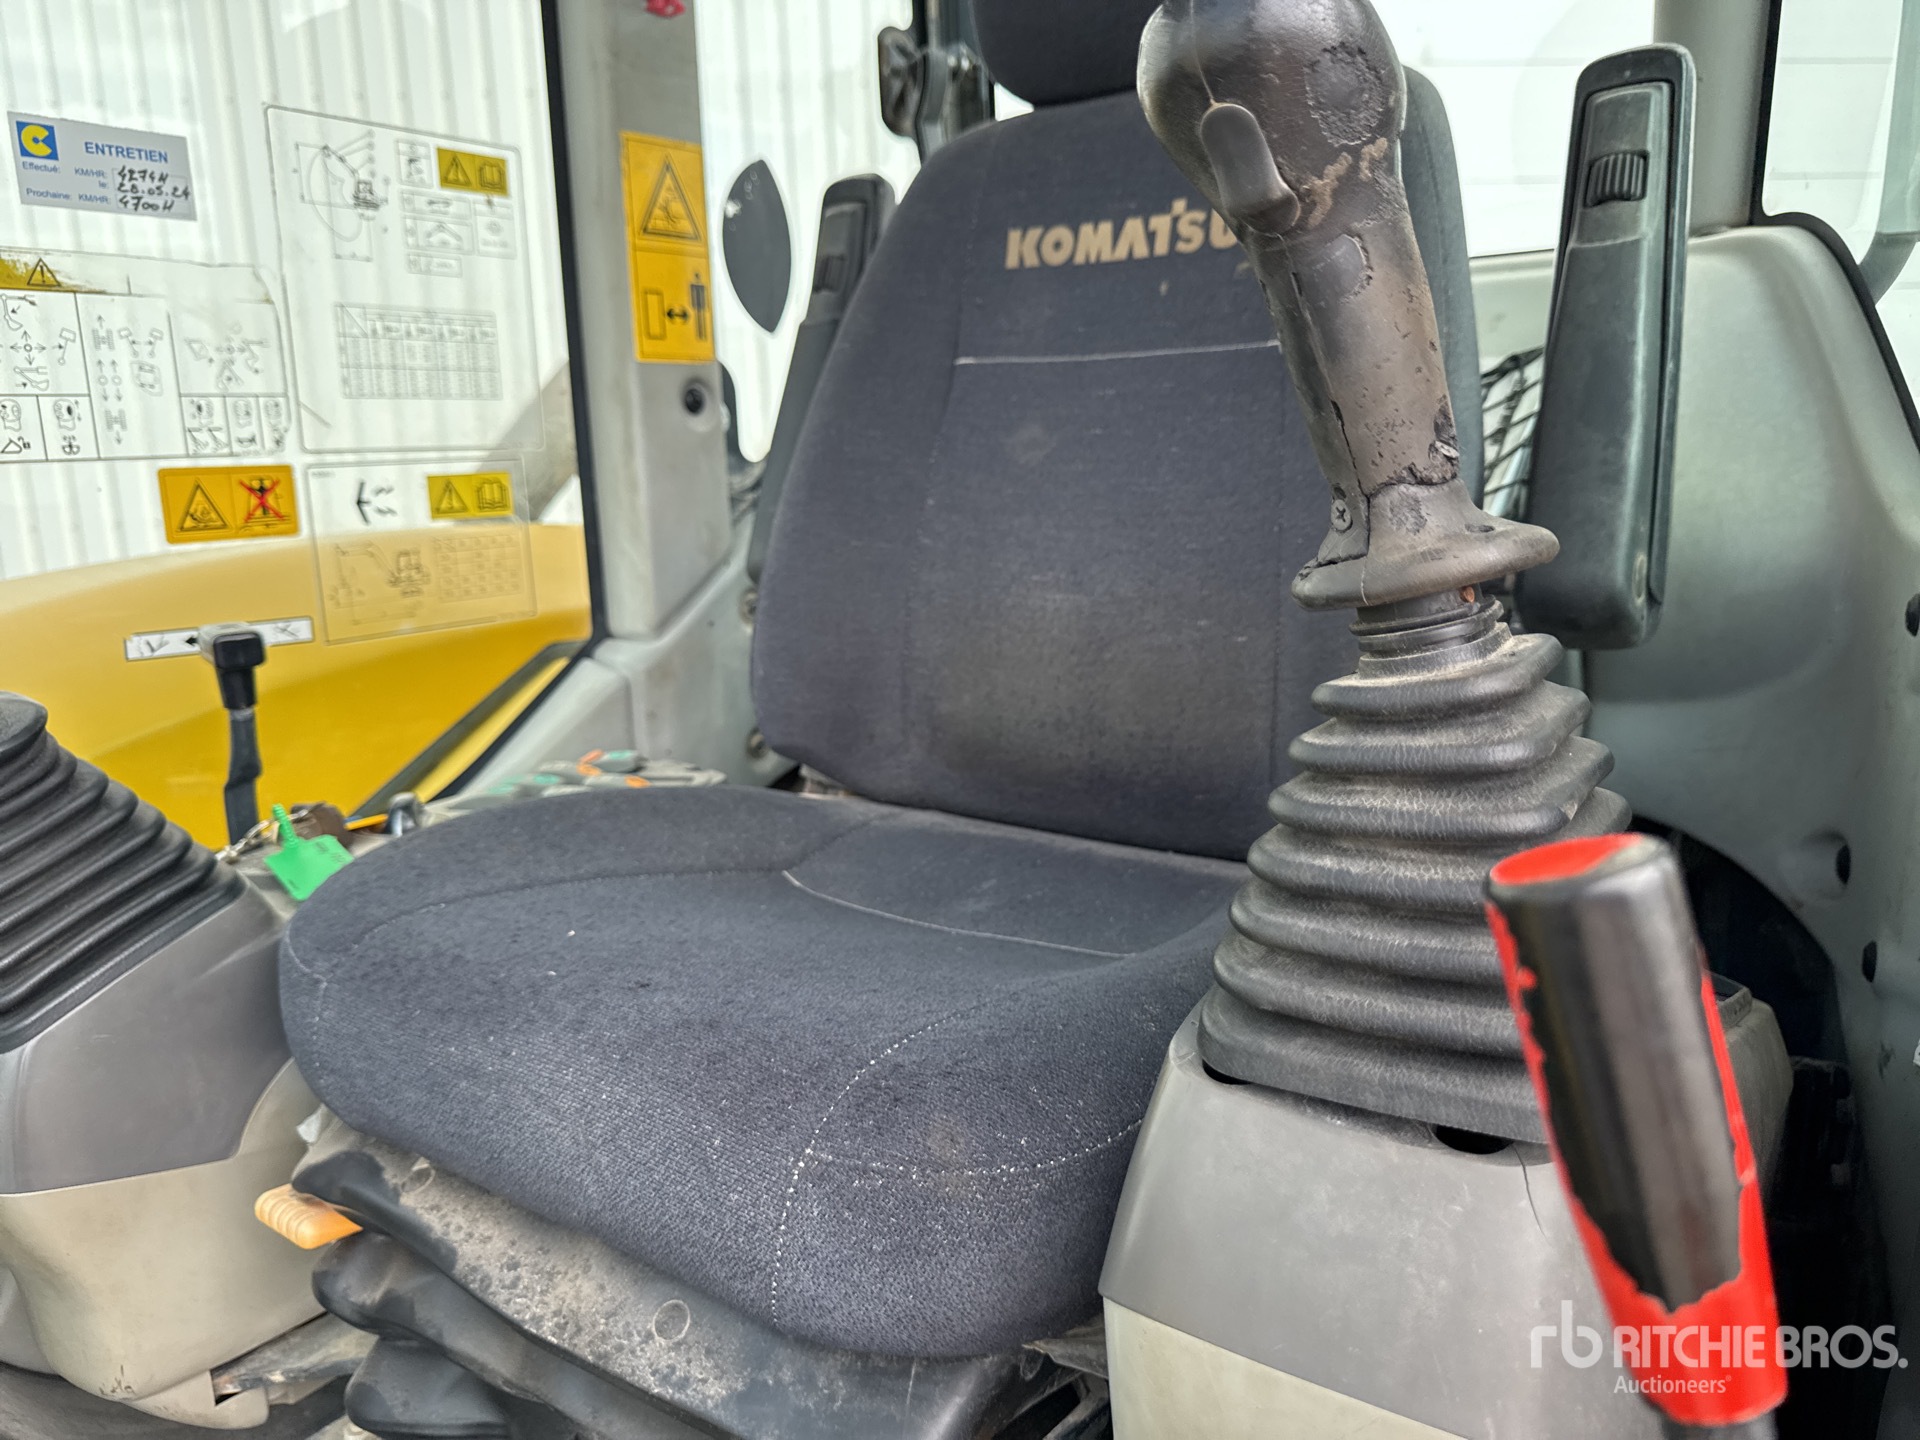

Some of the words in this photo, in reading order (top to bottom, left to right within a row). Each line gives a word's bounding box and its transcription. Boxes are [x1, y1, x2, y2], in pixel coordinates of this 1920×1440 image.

[84, 141, 169, 164] ENTRETIEN
[22, 160, 61, 174] Effectué:
[74, 167, 107, 179] KM/HR:
